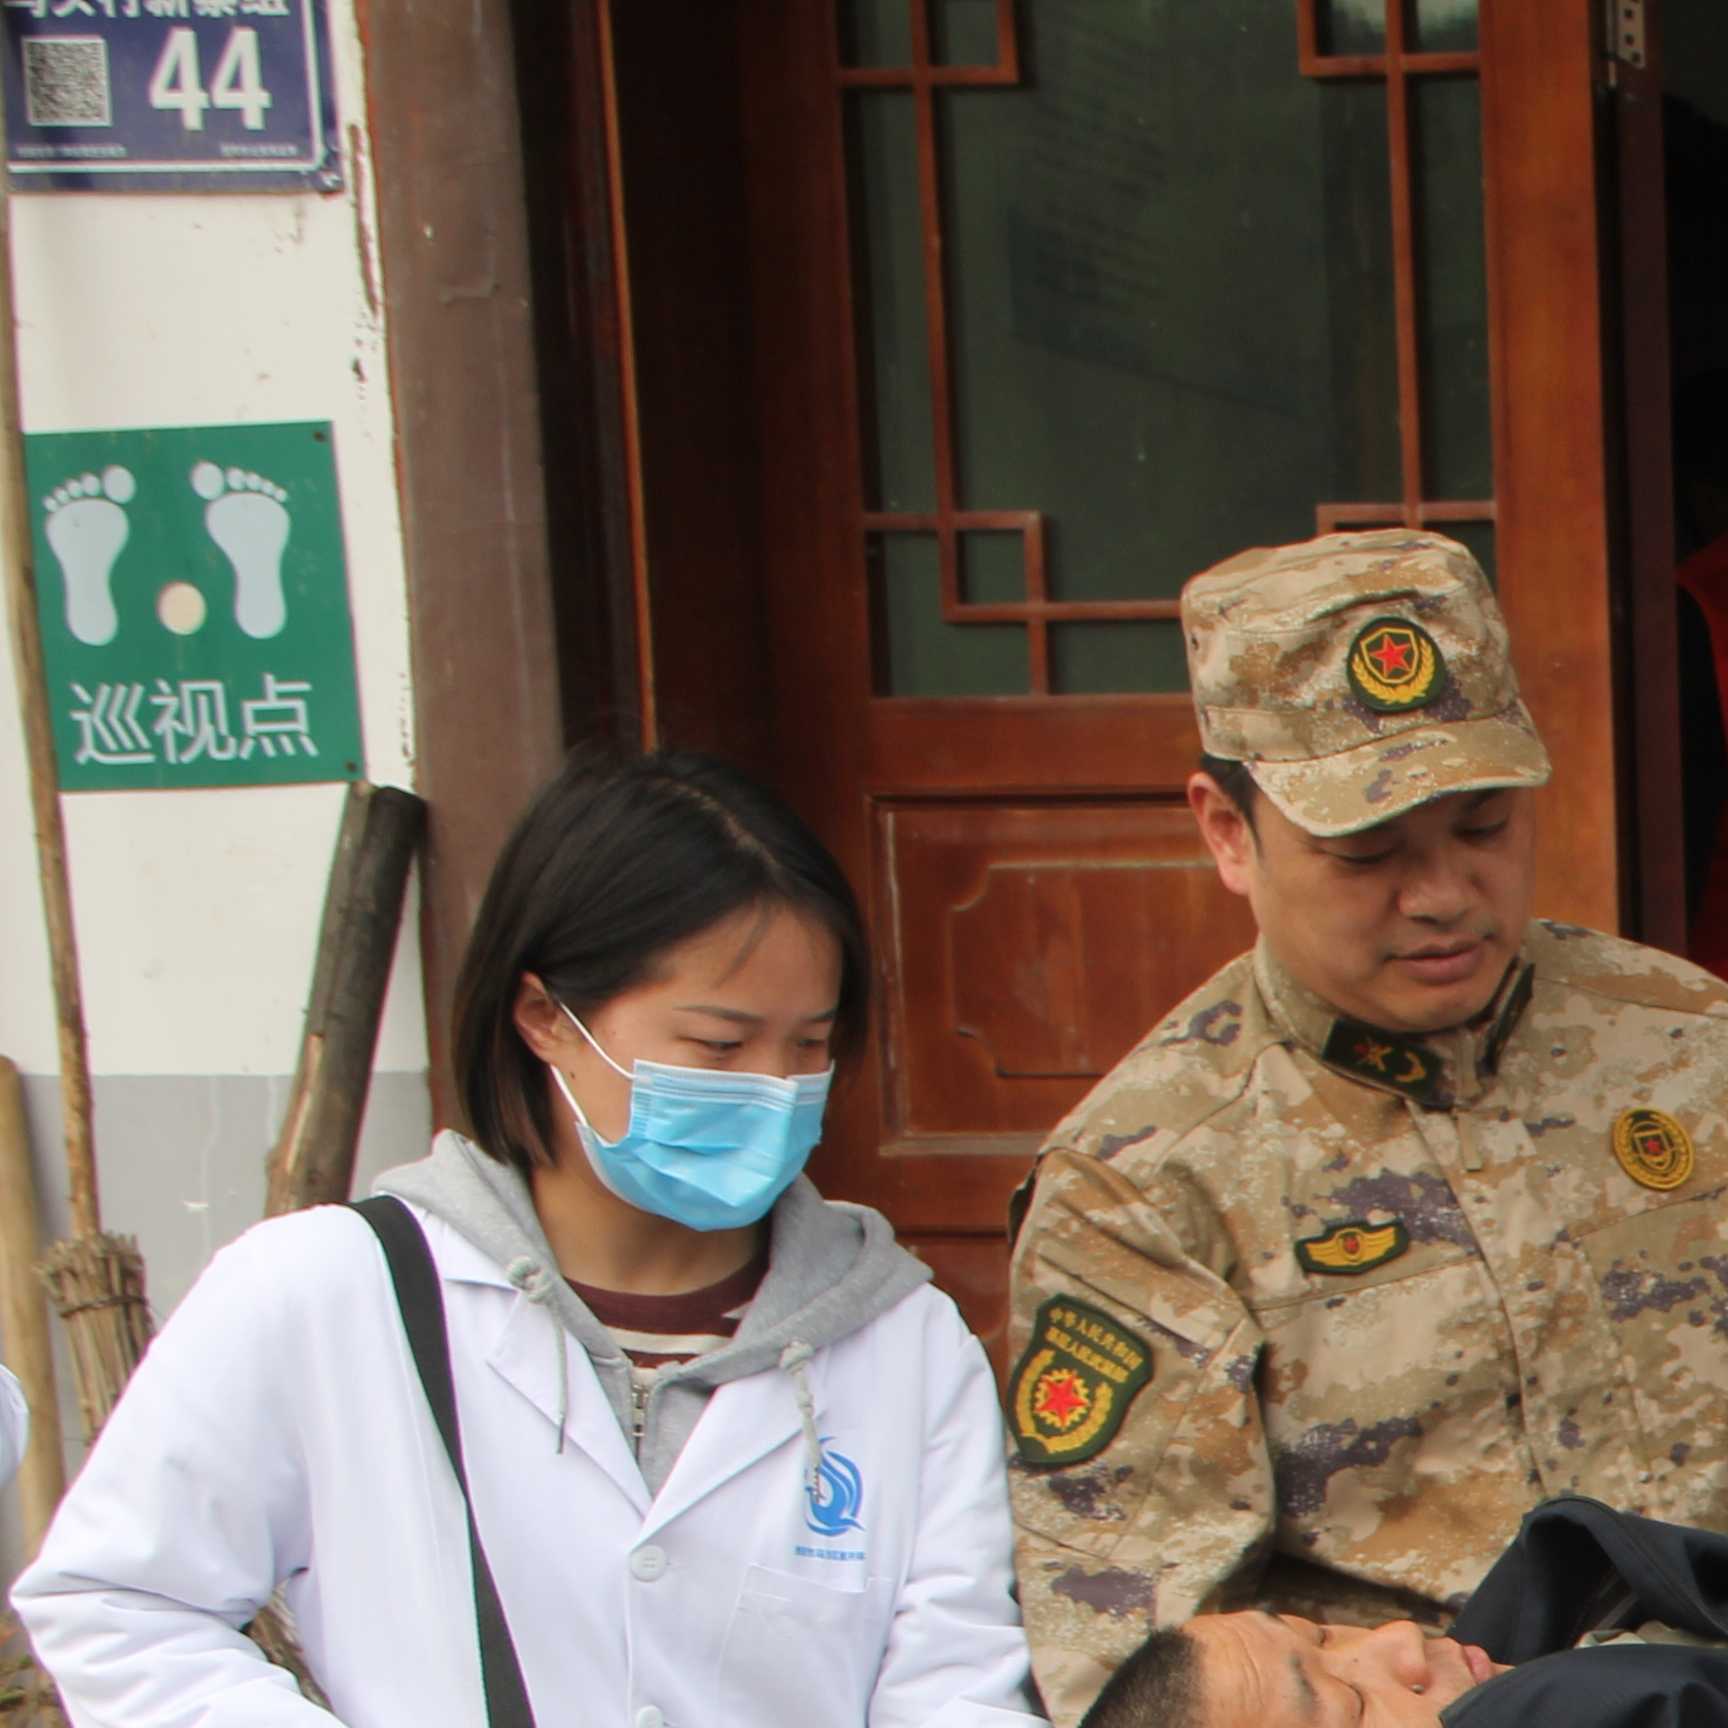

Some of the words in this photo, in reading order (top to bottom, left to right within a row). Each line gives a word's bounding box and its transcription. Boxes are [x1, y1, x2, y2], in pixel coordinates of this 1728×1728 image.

[149, 26, 272, 131] 44
[69, 673, 319, 765] 巡视点
